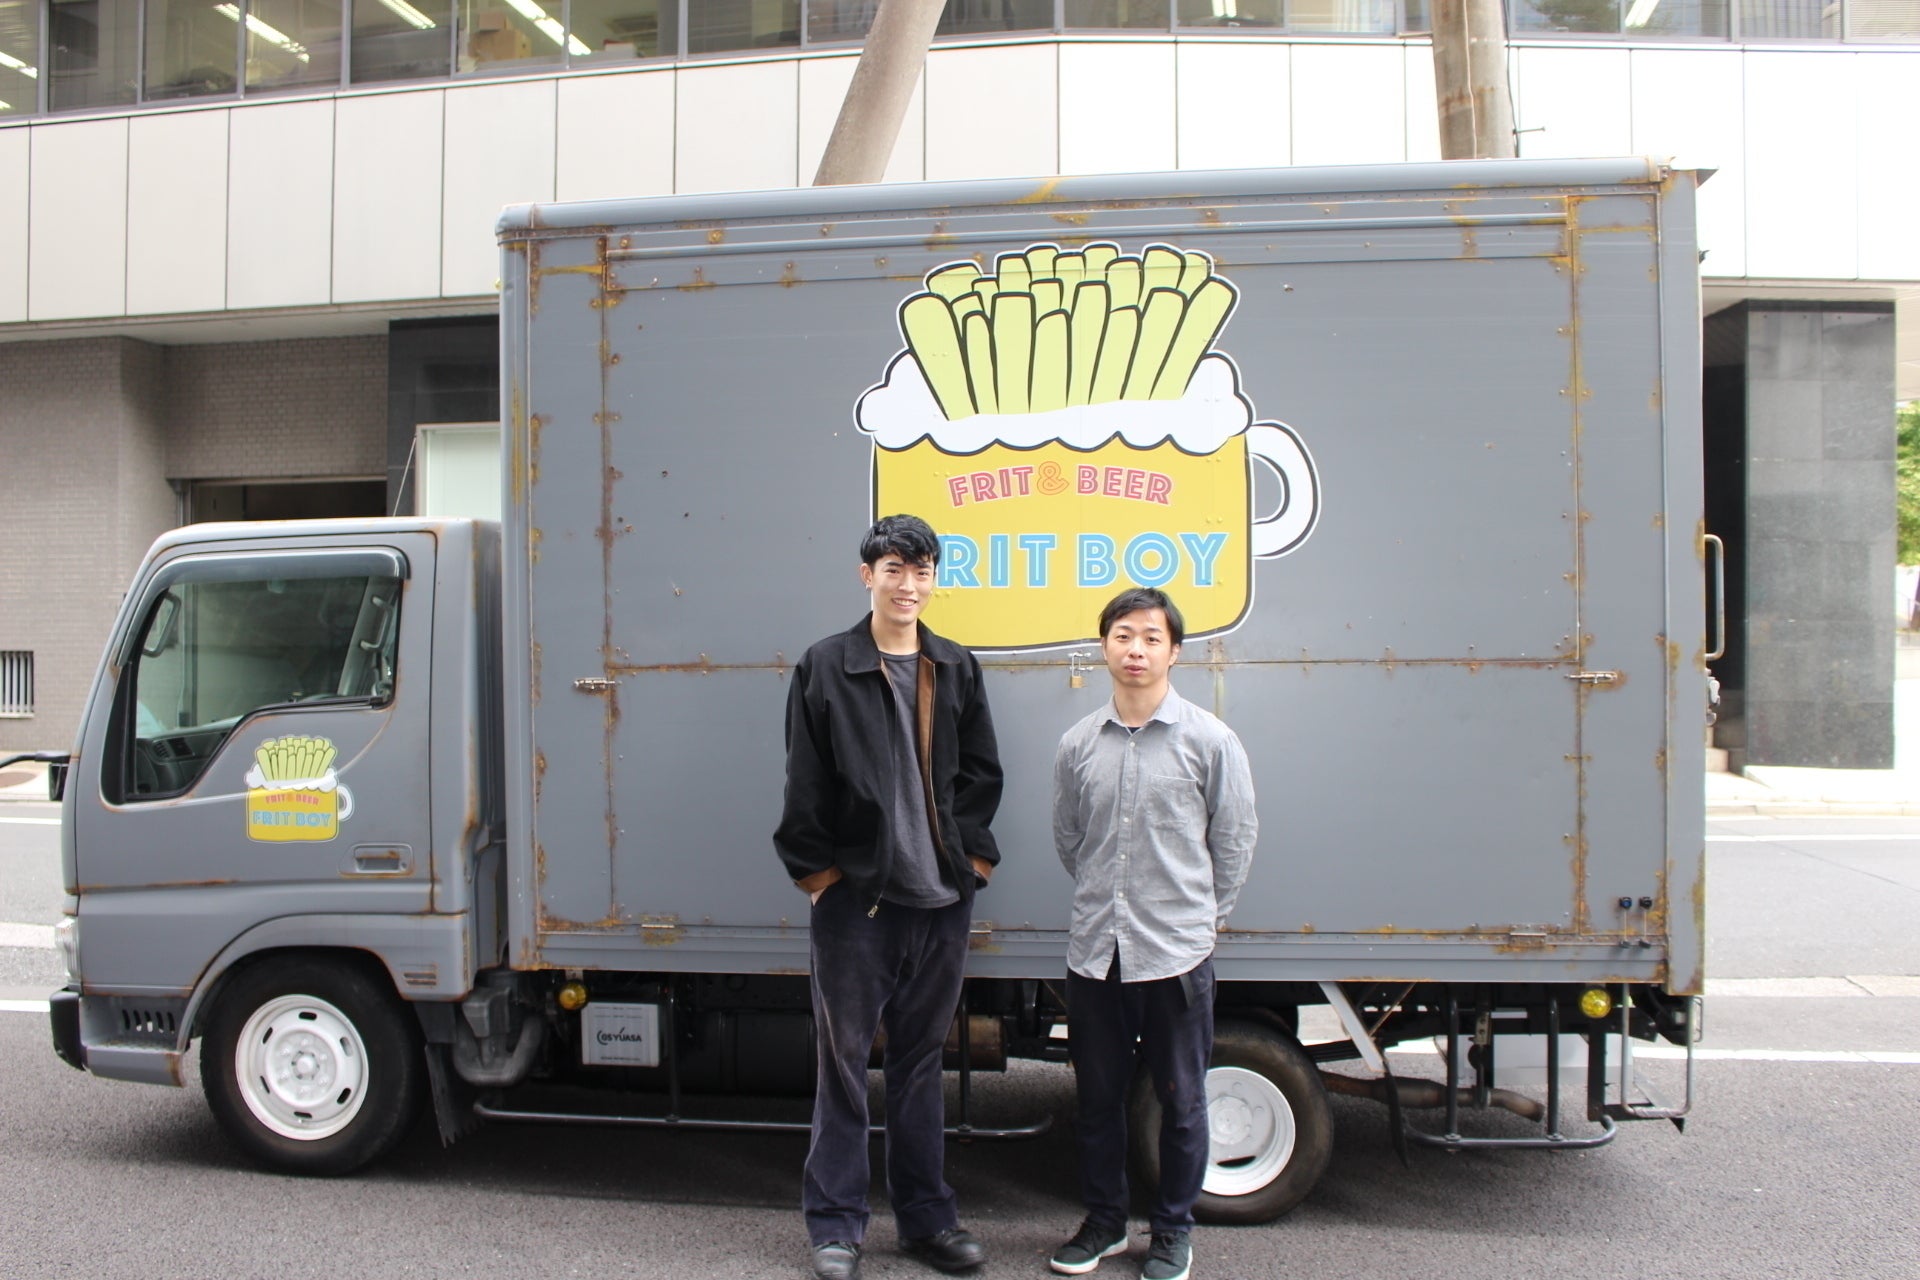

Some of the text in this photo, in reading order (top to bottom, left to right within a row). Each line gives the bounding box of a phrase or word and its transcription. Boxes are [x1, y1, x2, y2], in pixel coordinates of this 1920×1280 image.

[948, 465, 1034, 507] FRIT
[1075, 464, 1173, 505] BEER
[935, 532, 1228, 588] RIT BOY
[253, 811, 332, 827] FRIT BOY
